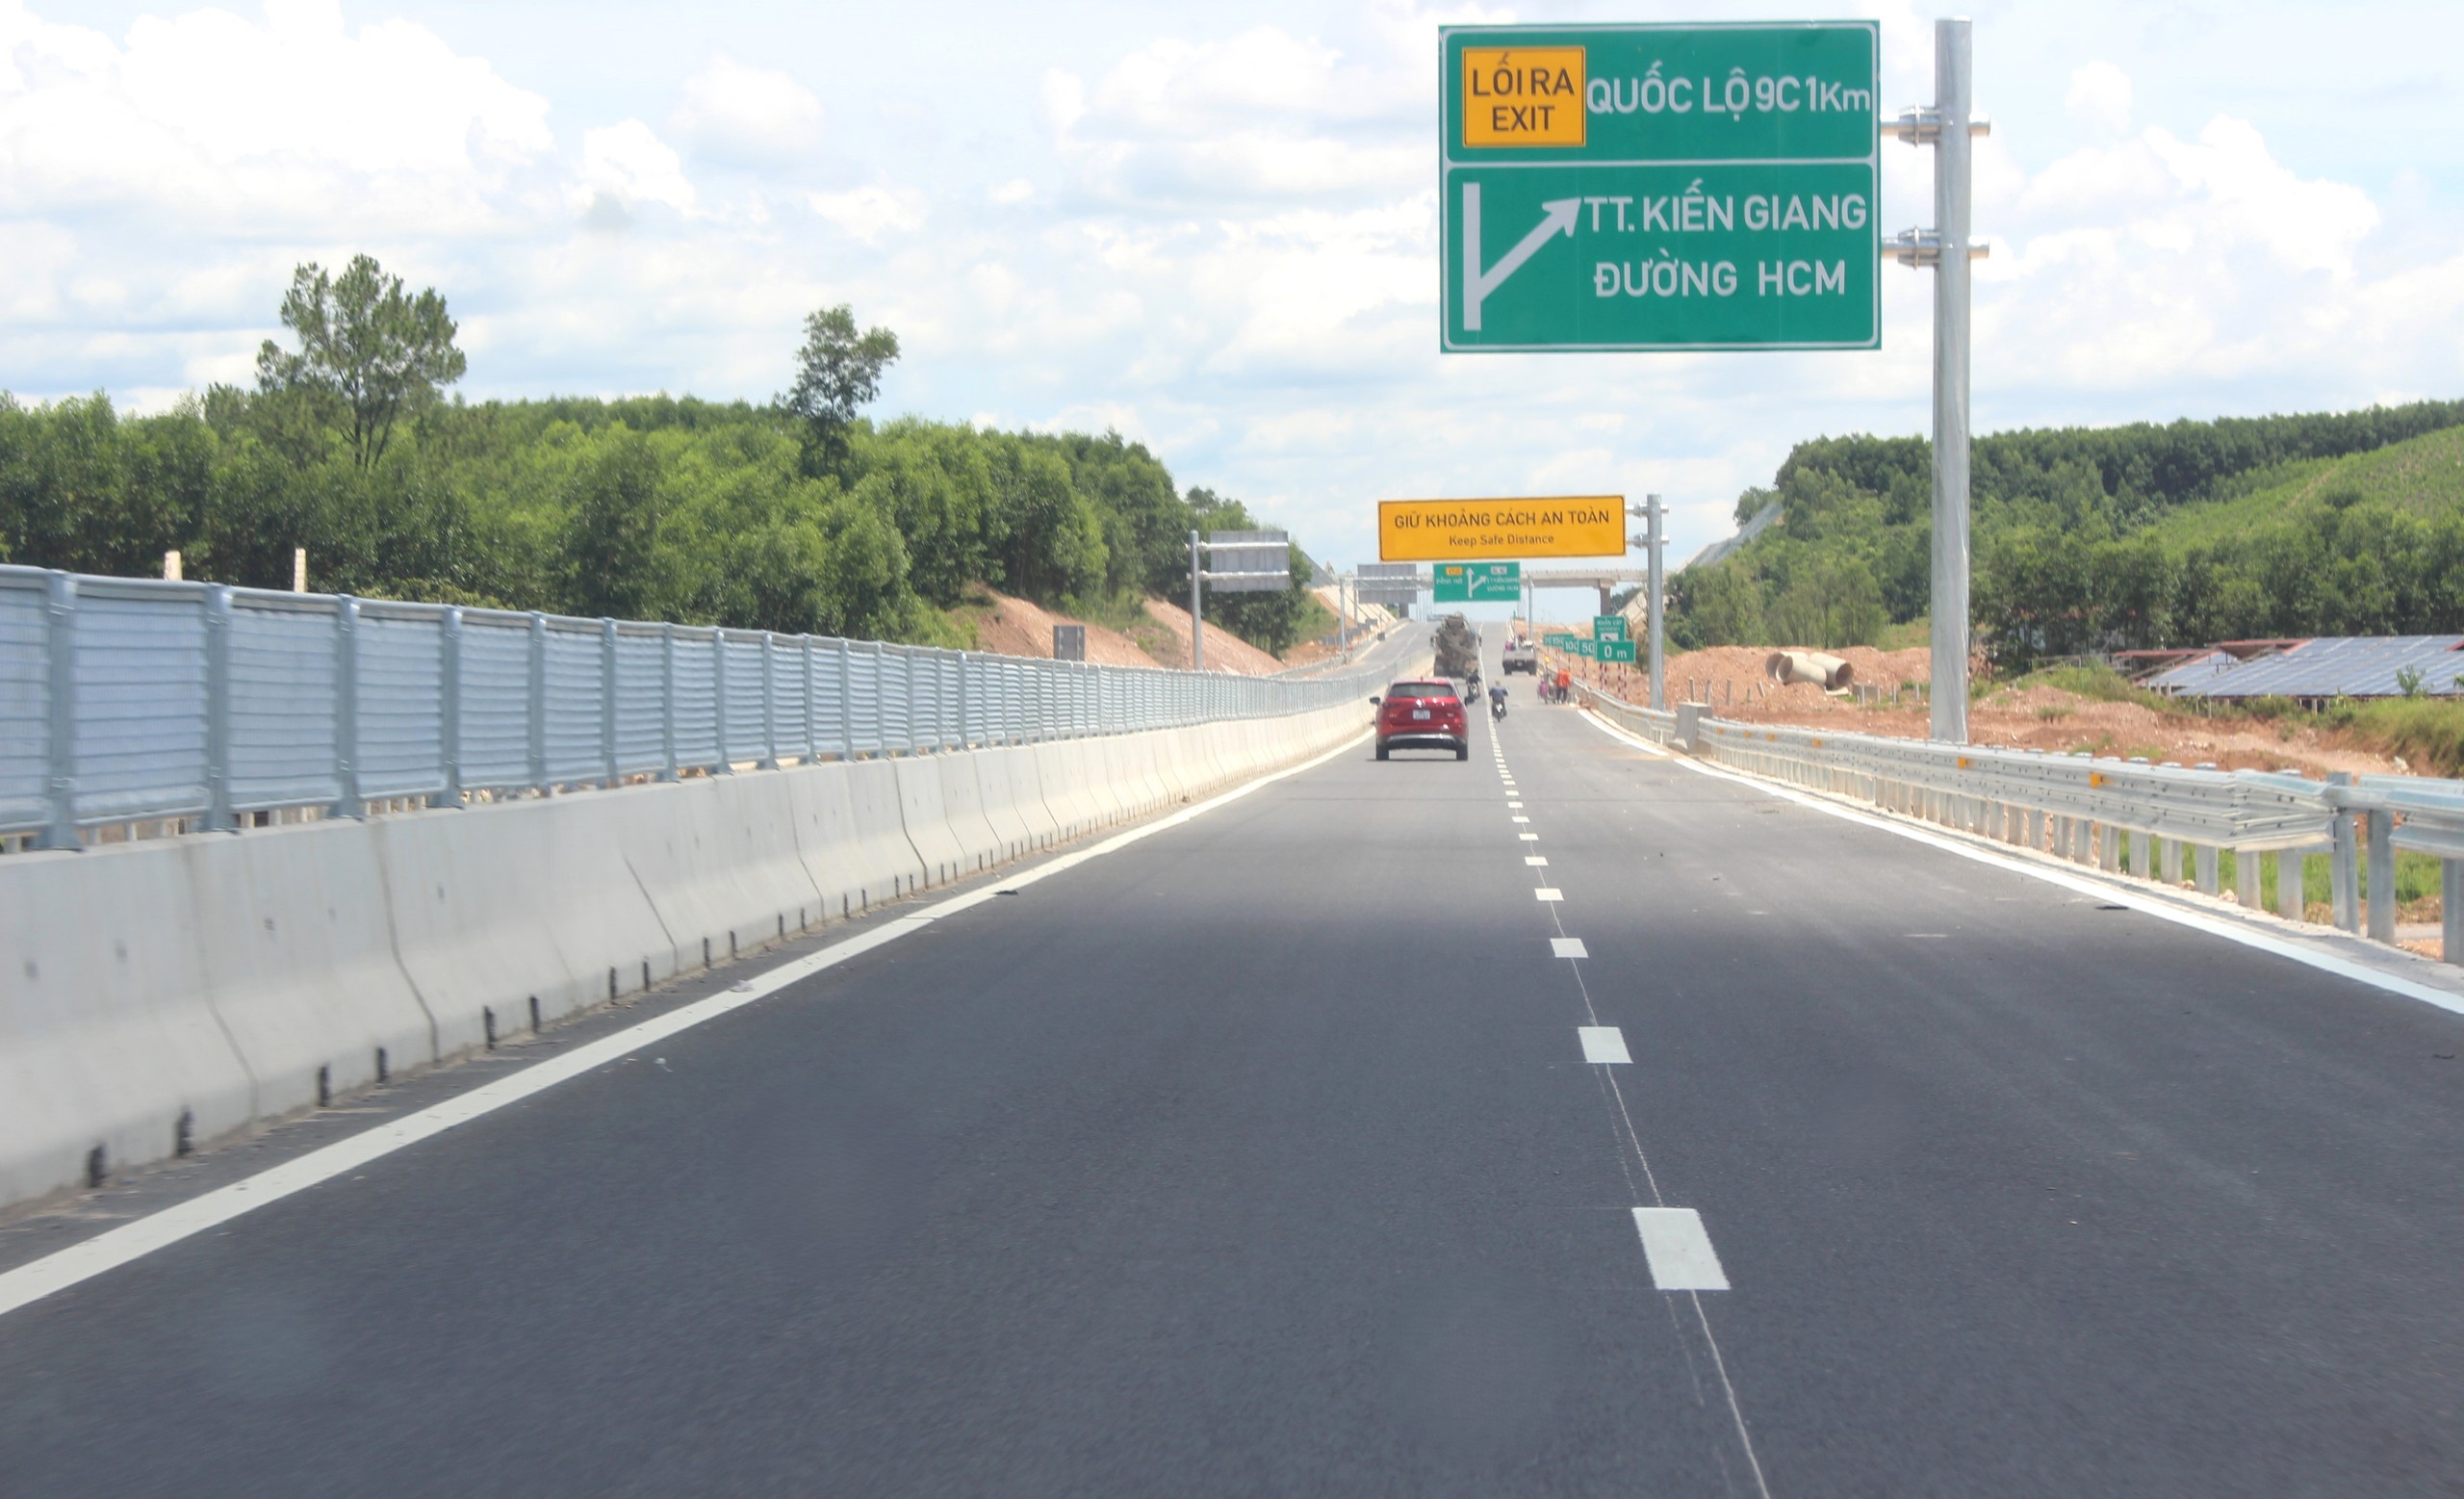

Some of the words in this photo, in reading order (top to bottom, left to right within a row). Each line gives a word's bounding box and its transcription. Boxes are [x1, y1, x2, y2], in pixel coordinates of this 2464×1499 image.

[1473, 52, 1523, 96] LỐI
[1530, 67, 1575, 96] RA
[1586, 60, 1693, 114] QUỐC
[1703, 66, 1750, 122] LỘ
[1756, 75, 1801, 113] 9C
[1493, 105, 1555, 132] EXIT
[1583, 195, 1635, 232] TT.
[1643, 178, 1733, 232] KIẾN
[1743, 194, 1867, 231] GIANG
[1594, 247, 1738, 297] ĐƯỜNG
[1758, 259, 1846, 297] HCM
[1395, 510, 1421, 529] GIỮ
[1426, 507, 1491, 528] KHOẢNG
[1496, 506, 1536, 527] CÁCH
[1541, 510, 1564, 526] AN
[1567, 505, 1610, 525] TOÀN
[1449, 535, 1477, 549] Keep
[1480, 533, 1504, 546] Safe
[1507, 533, 1555, 546] Distance
[1604, 645, 1612, 659] 0
[1617, 650, 1627, 659] m
